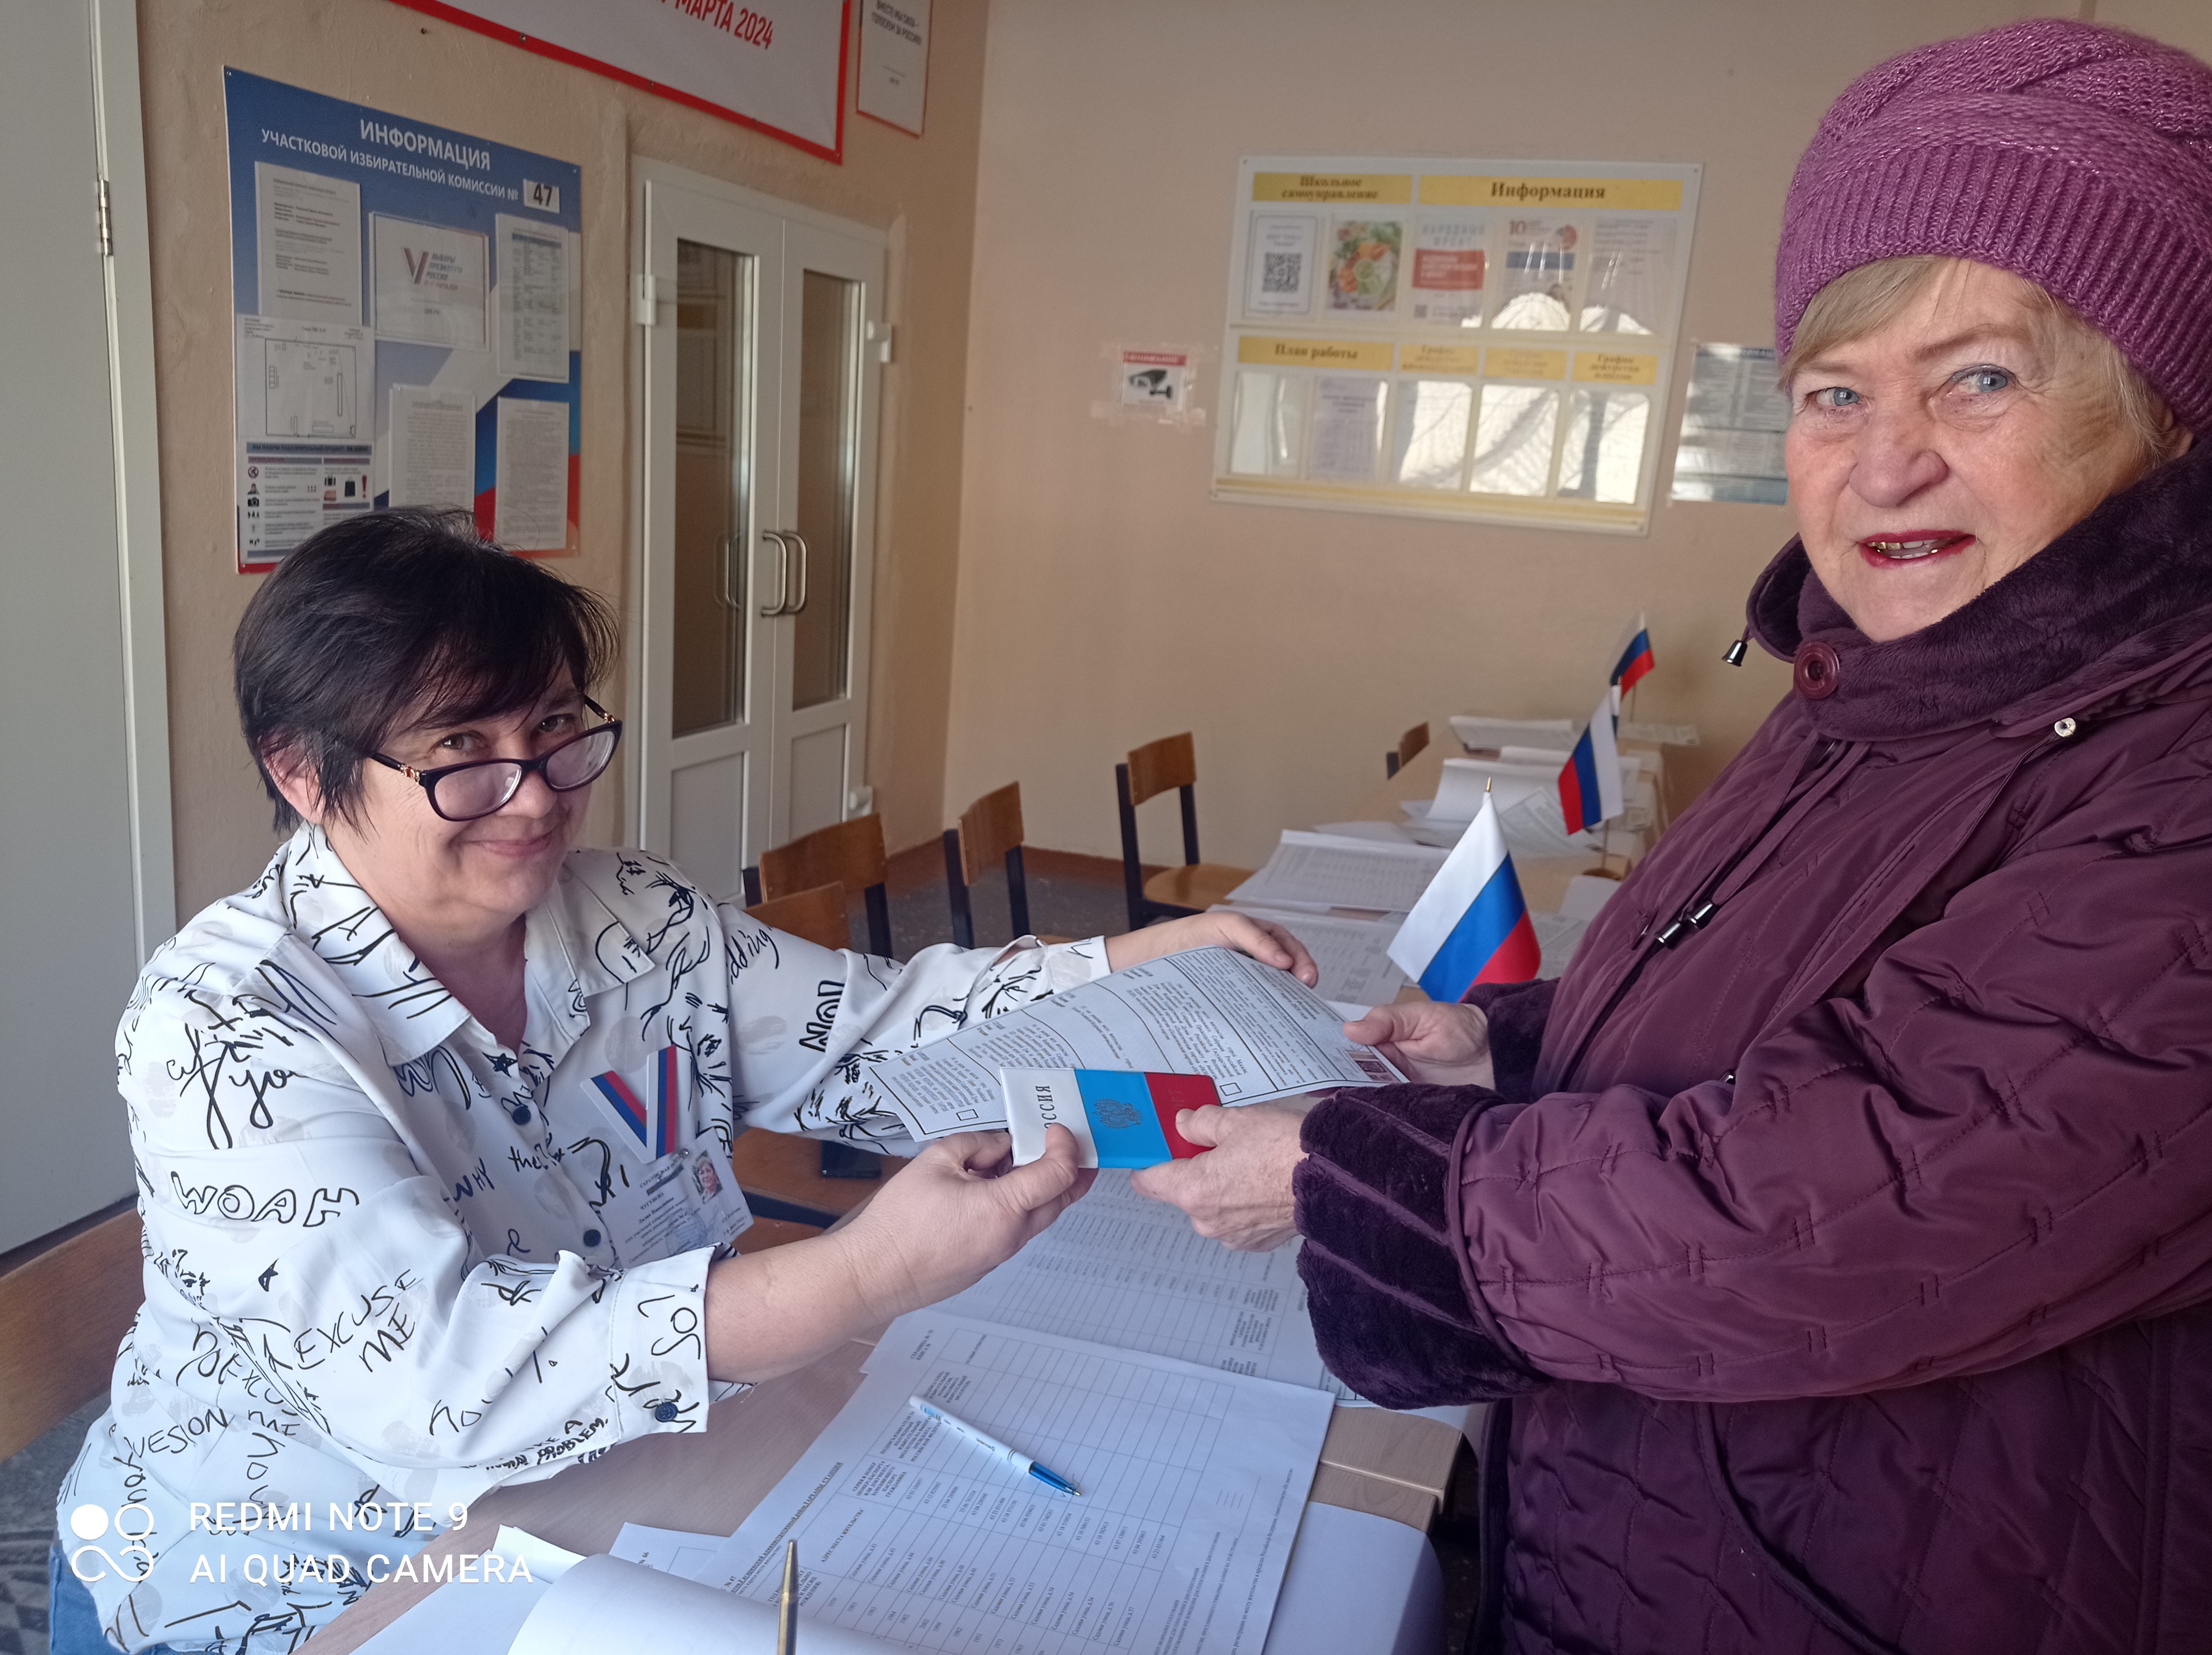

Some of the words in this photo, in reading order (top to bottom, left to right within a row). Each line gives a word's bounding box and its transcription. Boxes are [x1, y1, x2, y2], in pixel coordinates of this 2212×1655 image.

[734, 8, 773, 50] 2024
[360, 118, 491, 171] ИНФОРМАЦИЯ
[262, 128, 347, 162] УЧАСТКОВОЙ
[350, 150, 446, 185] ИЗБИРАТЕЛЬНОЙ
[448, 174, 505, 198] КОМИССИИ
[508, 187, 519, 200] №
[533, 181, 552, 208] 47
[1281, 188, 1379, 201] самоуправление
[1490, 181, 1606, 201] Информация
[1275, 343, 1307, 360] План
[1310, 346, 1358, 362] работы
[1193, 1032, 1211, 1054] Российской
[1211, 1047, 1235, 1079] Государственной
[1224, 1053, 1243, 1077] Российской
[1035, 1086, 1057, 1129] ССИЯ
[294, 1269, 418, 1370] EXCUSE
[359, 1302, 416, 1372] ME
[820, 1461, 843, 1484] СТАНЦИЯ
